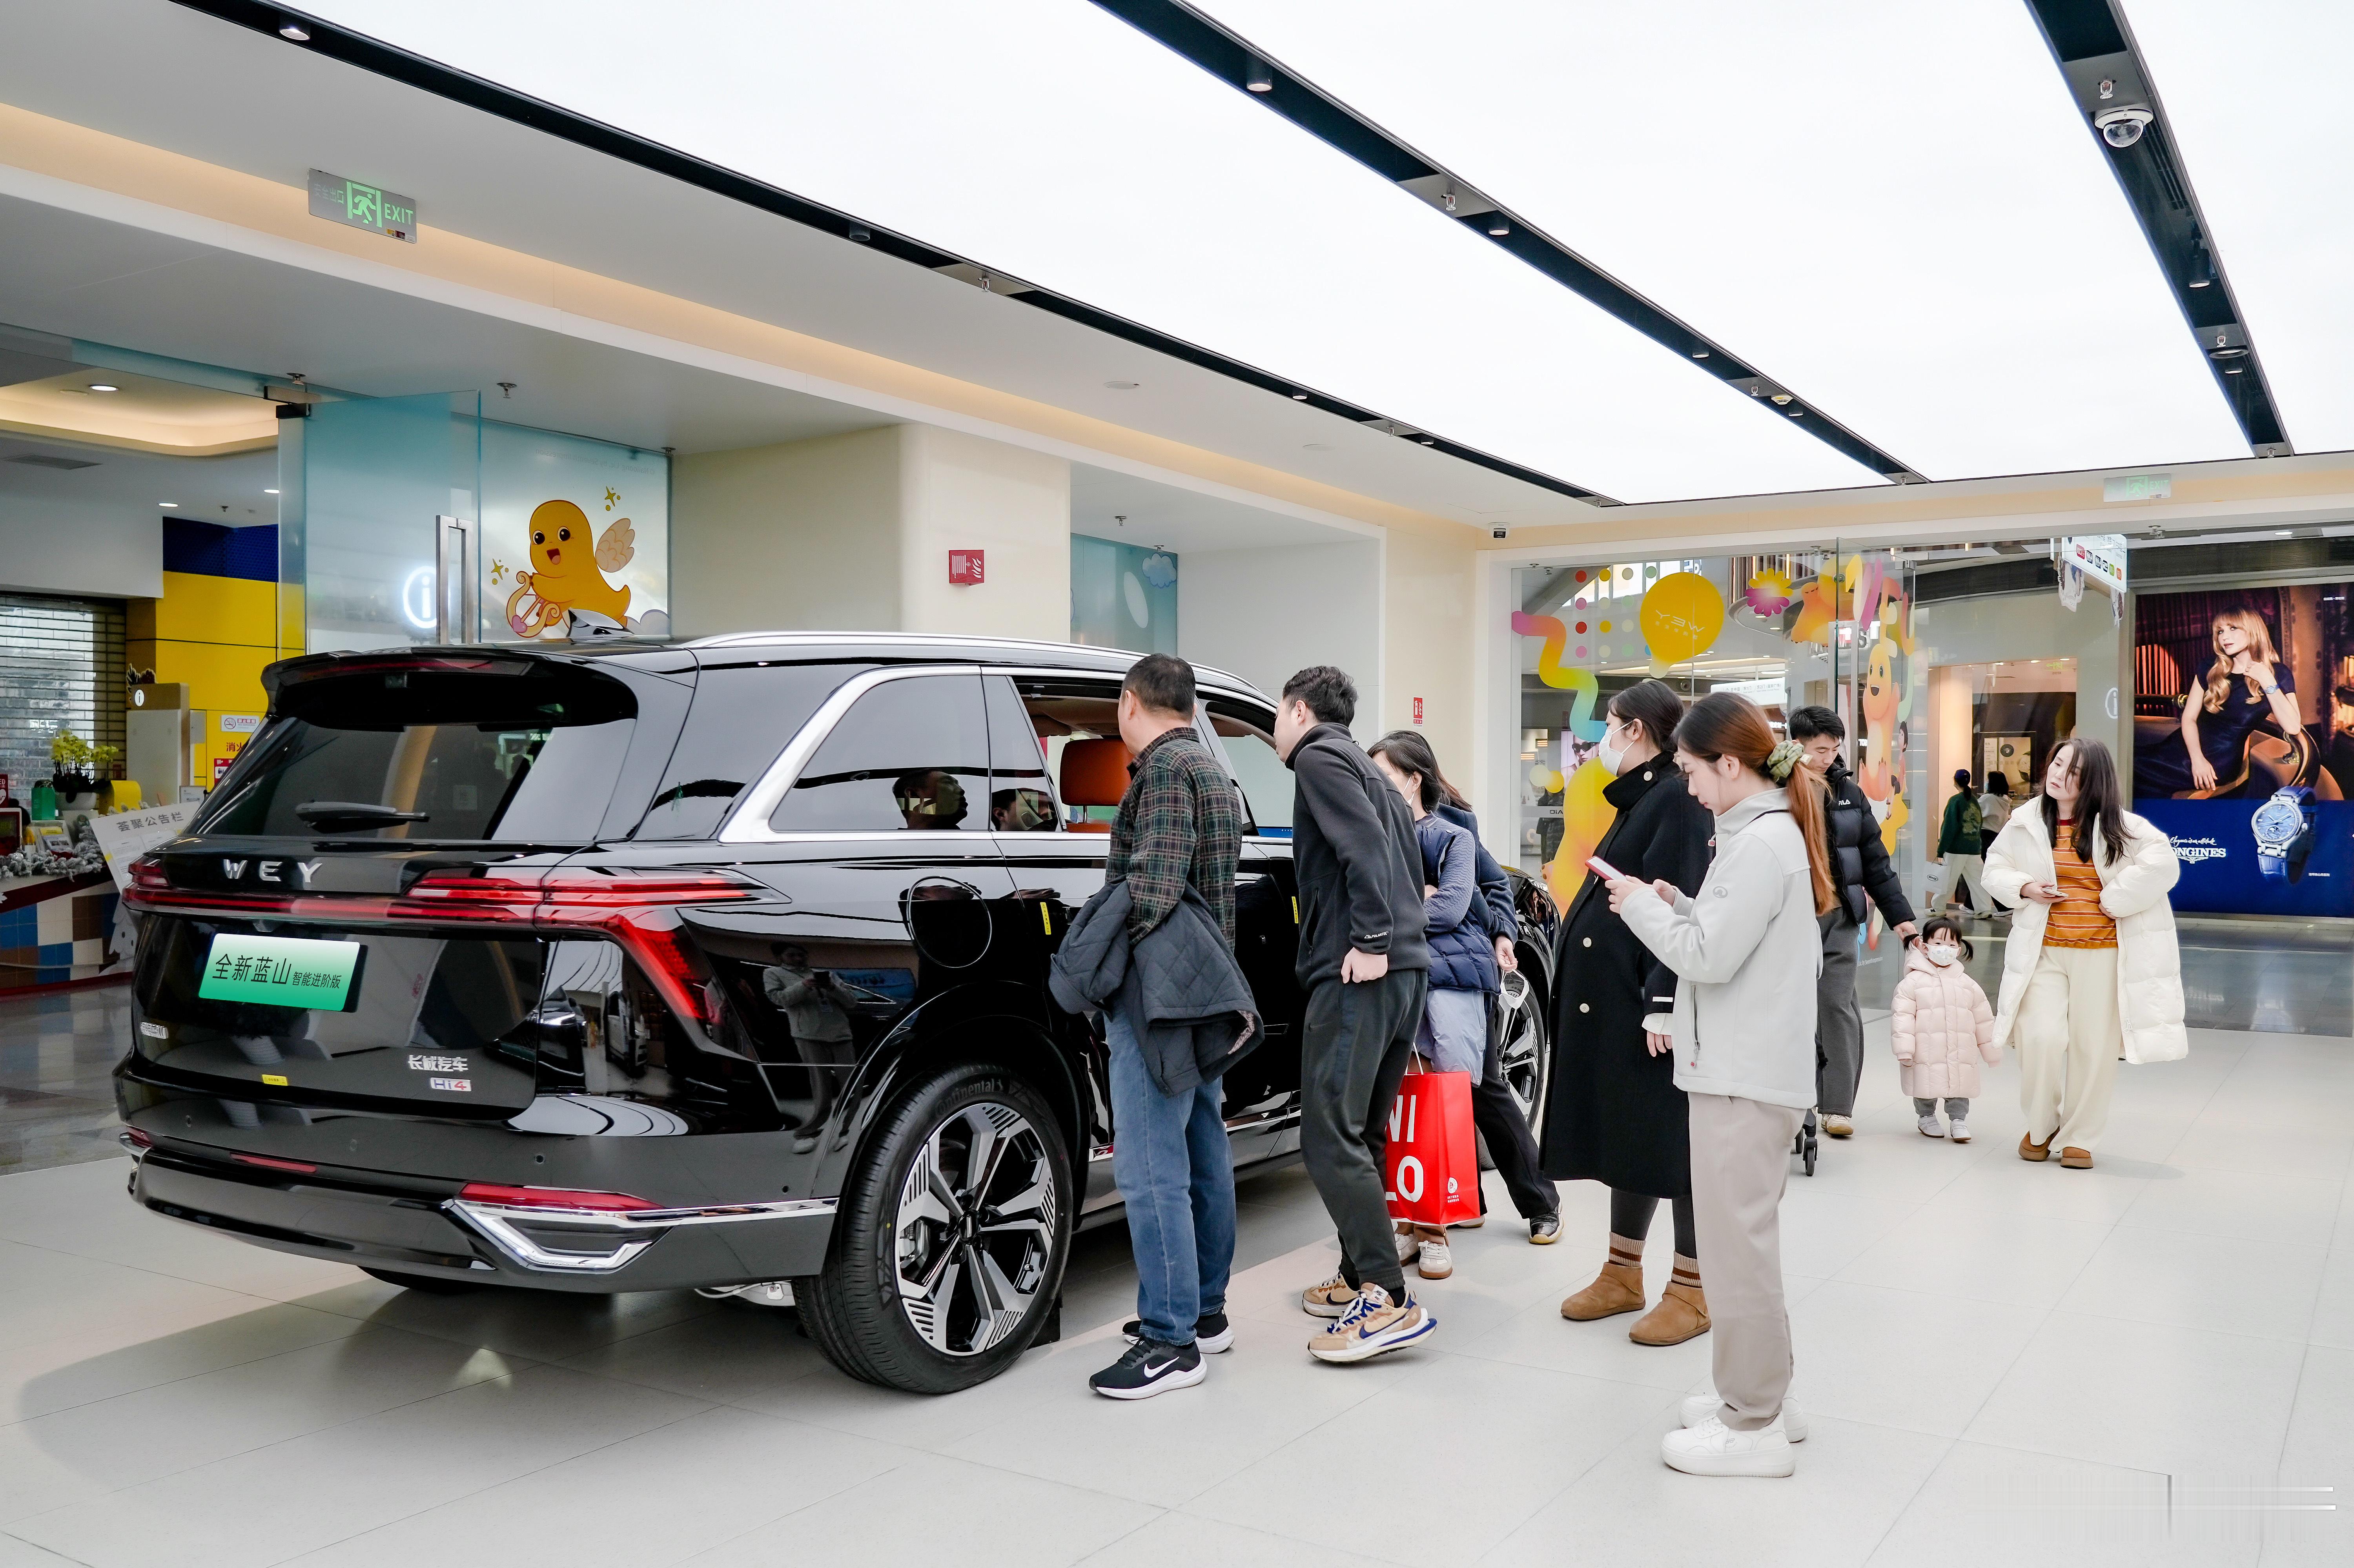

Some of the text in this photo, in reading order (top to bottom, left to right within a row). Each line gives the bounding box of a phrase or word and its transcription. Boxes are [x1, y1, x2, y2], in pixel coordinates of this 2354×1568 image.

[384, 203, 413, 225] EXIT
[2150, 480, 2169, 490] EXIT
[117, 811, 184, 832] 荟聚公告栏
[223, 859, 322, 883] WEY
[212, 953, 342, 989] 全新蓝山 智能进阶版
[408, 1054, 468, 1072] 长城汽车
[434, 1079, 467, 1090] Hi4
